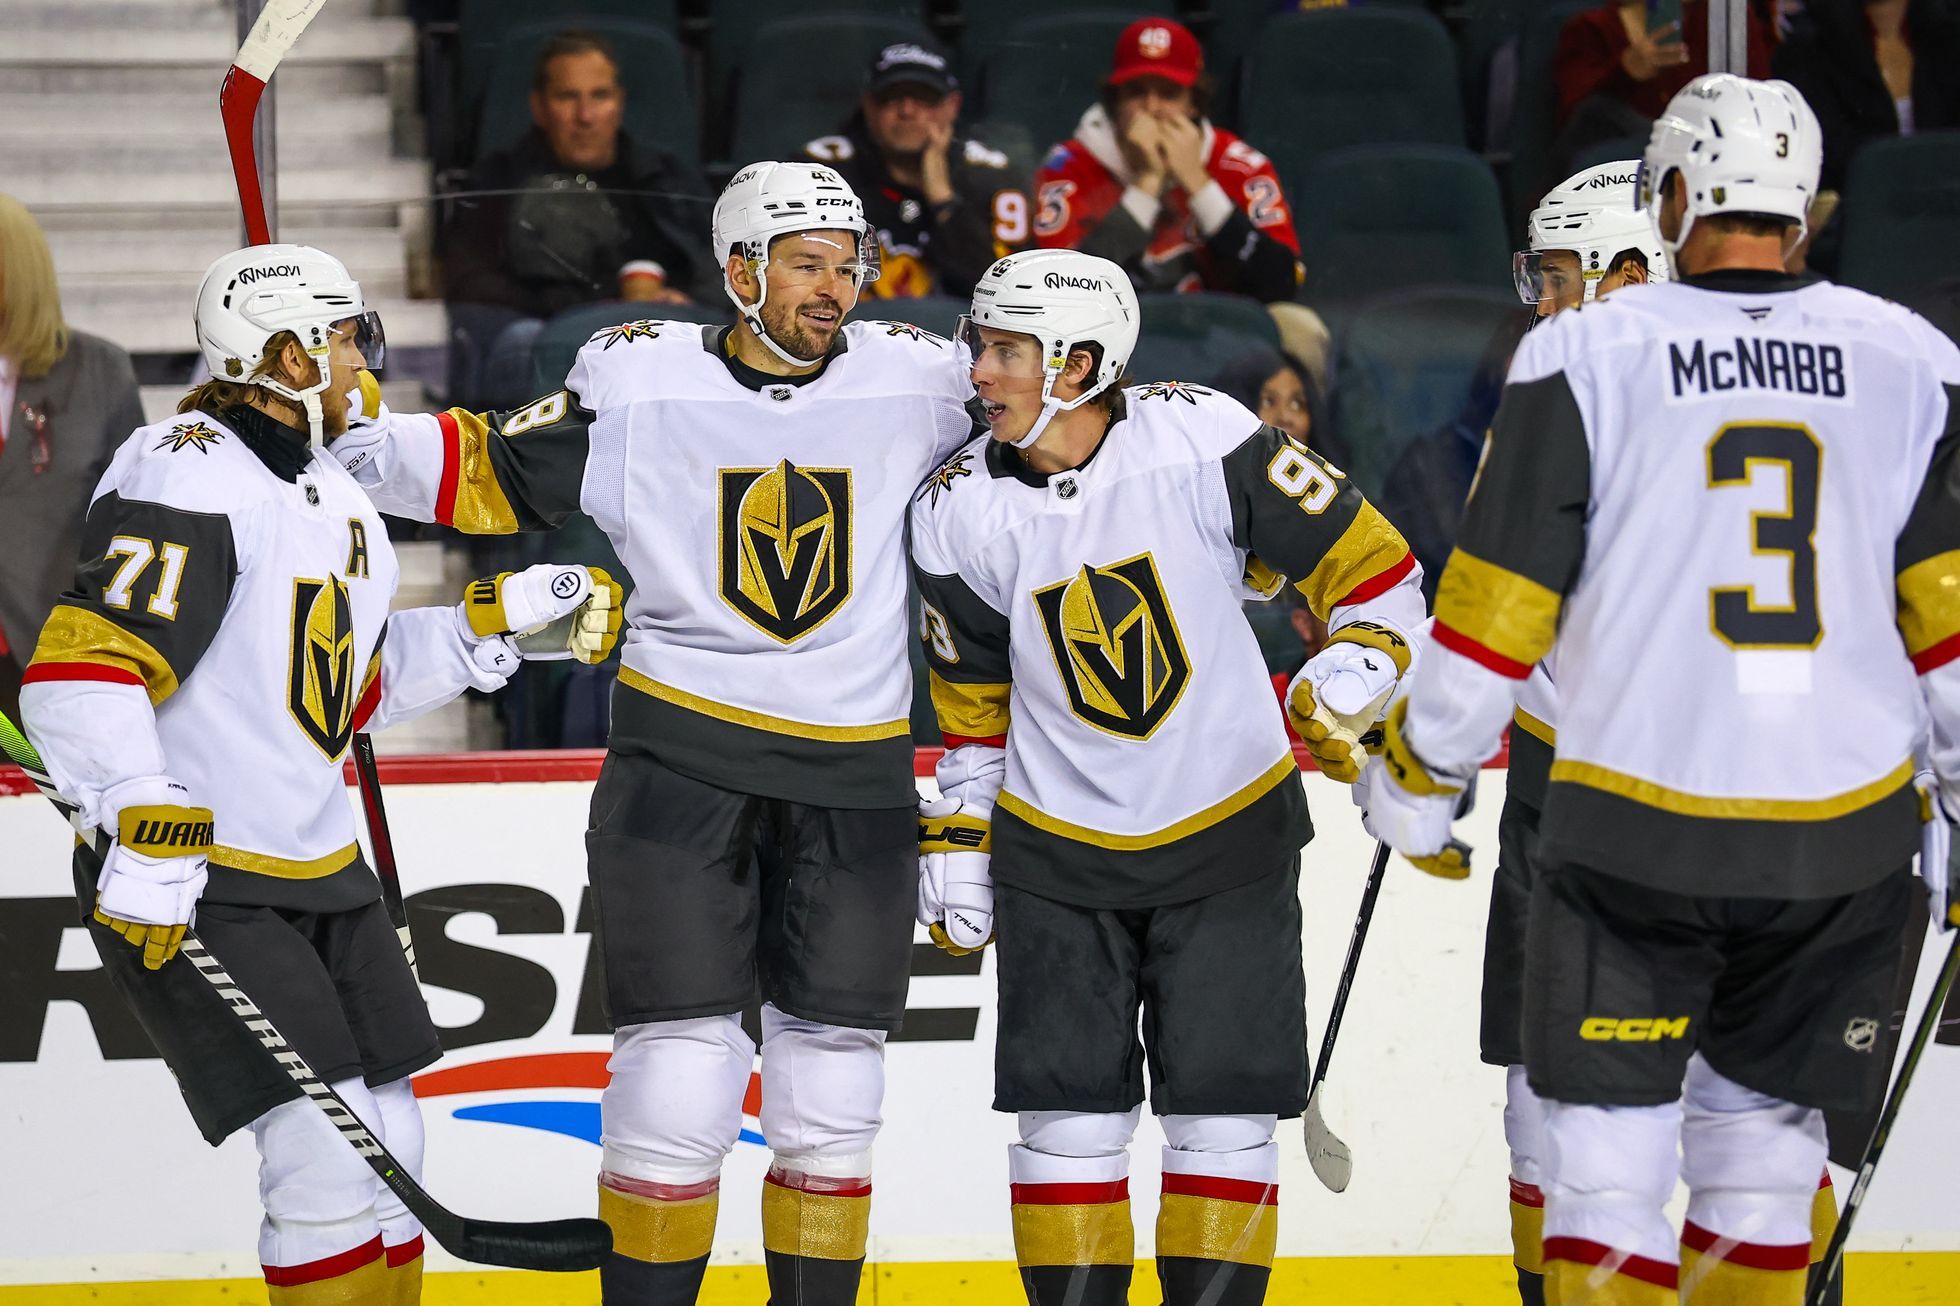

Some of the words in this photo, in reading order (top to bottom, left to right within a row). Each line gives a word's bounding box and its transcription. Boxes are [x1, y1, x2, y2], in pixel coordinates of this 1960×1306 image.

[1775, 131, 1789, 159] 3
[815, 197, 854, 208] CCM
[993, 190, 1029, 243] 9
[1243, 176, 1287, 229] 2
[254, 265, 302, 280] NAQVI
[1060, 275, 1102, 292] NAQVI
[1668, 335, 1847, 400] McNABB
[500, 390, 568, 437] 8
[1266, 434, 1347, 514] 9
[344, 517, 370, 580] A
[1705, 418, 1824, 651] 3
[102, 534, 190, 622] 71
[954, 911, 983, 935] TRUE
[1579, 1015, 1690, 1041] CCM
